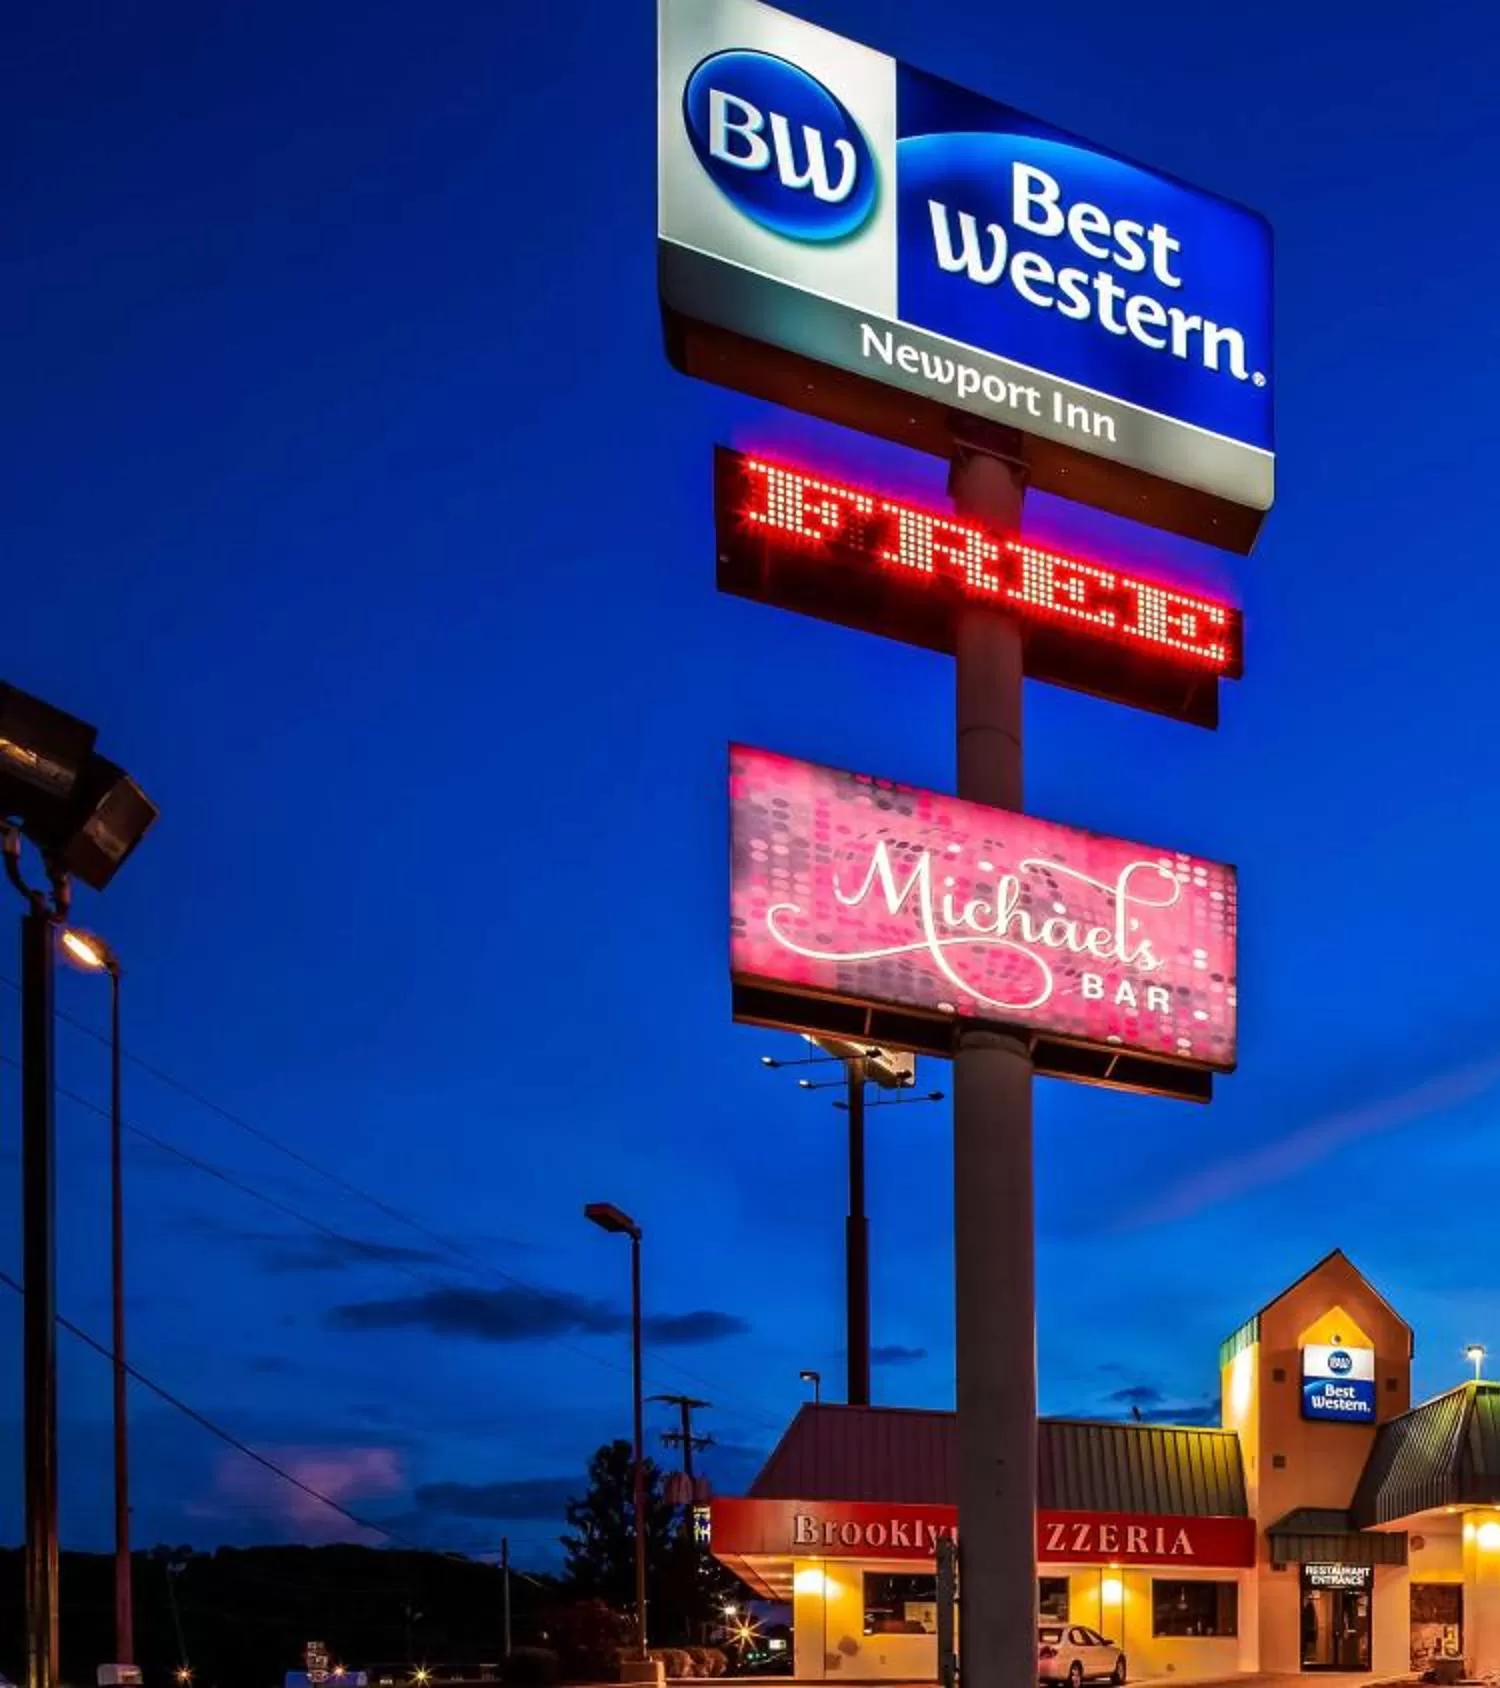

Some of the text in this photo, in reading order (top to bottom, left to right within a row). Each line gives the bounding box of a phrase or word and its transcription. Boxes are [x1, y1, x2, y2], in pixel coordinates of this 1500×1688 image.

[709, 89, 856, 203] BW
[1012, 161, 1183, 288] Best
[860, 323, 1117, 443] Newport Inn
[749, 461, 1225, 662] FREE
[767, 840, 1180, 1009] Michael's
[1081, 972, 1170, 1014] BAR
[1325, 1383, 1356, 1398] Best
[1046, 1523, 1195, 1555] ZZERIA
[1305, 1565, 1371, 1576] RESTAURANT
